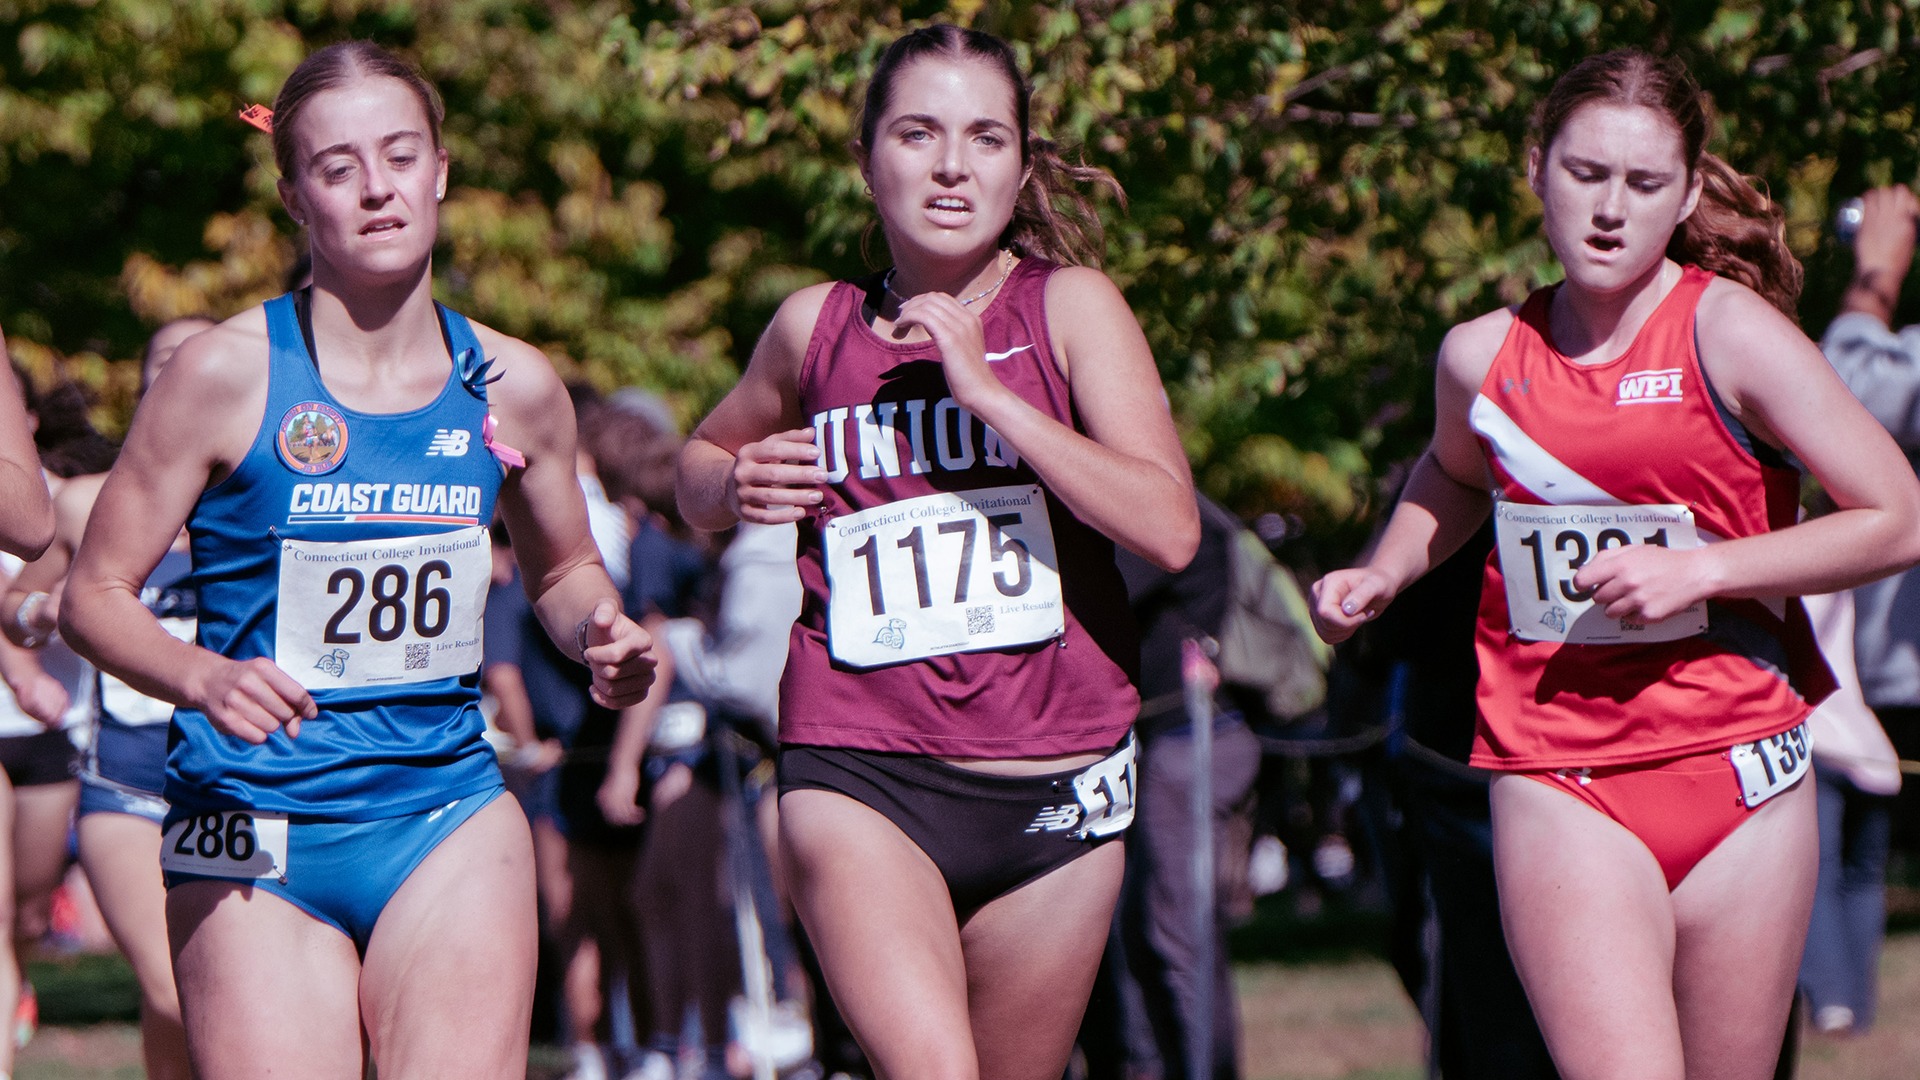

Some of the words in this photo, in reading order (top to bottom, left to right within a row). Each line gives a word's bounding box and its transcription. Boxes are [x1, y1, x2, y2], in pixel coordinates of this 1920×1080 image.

[1619, 374, 1683, 399] WPI
[290, 482, 390, 514] COAST
[392, 484, 481, 515] GUARD
[839, 513, 906, 539] Connecticut
[910, 504, 957, 519] College
[960, 494, 1032, 512] Invitational
[1505, 511, 1567, 524] Connecticut
[1571, 513, 1612, 525] College
[1615, 513, 1681, 524] Invitational
[294, 549, 368, 563] Connecticut
[372, 548, 416, 561] College
[419, 535, 481, 556] Invitational
[853, 512, 1033, 616] 1175
[1520, 527, 1670, 603] 13
[323, 559, 453, 644] 286
[1000, 605, 1021, 614] Live
[1022, 600, 1055, 611] Results
[436, 642, 453, 651] Live
[455, 637, 480, 648] Results
[174, 811, 256, 862] 286
